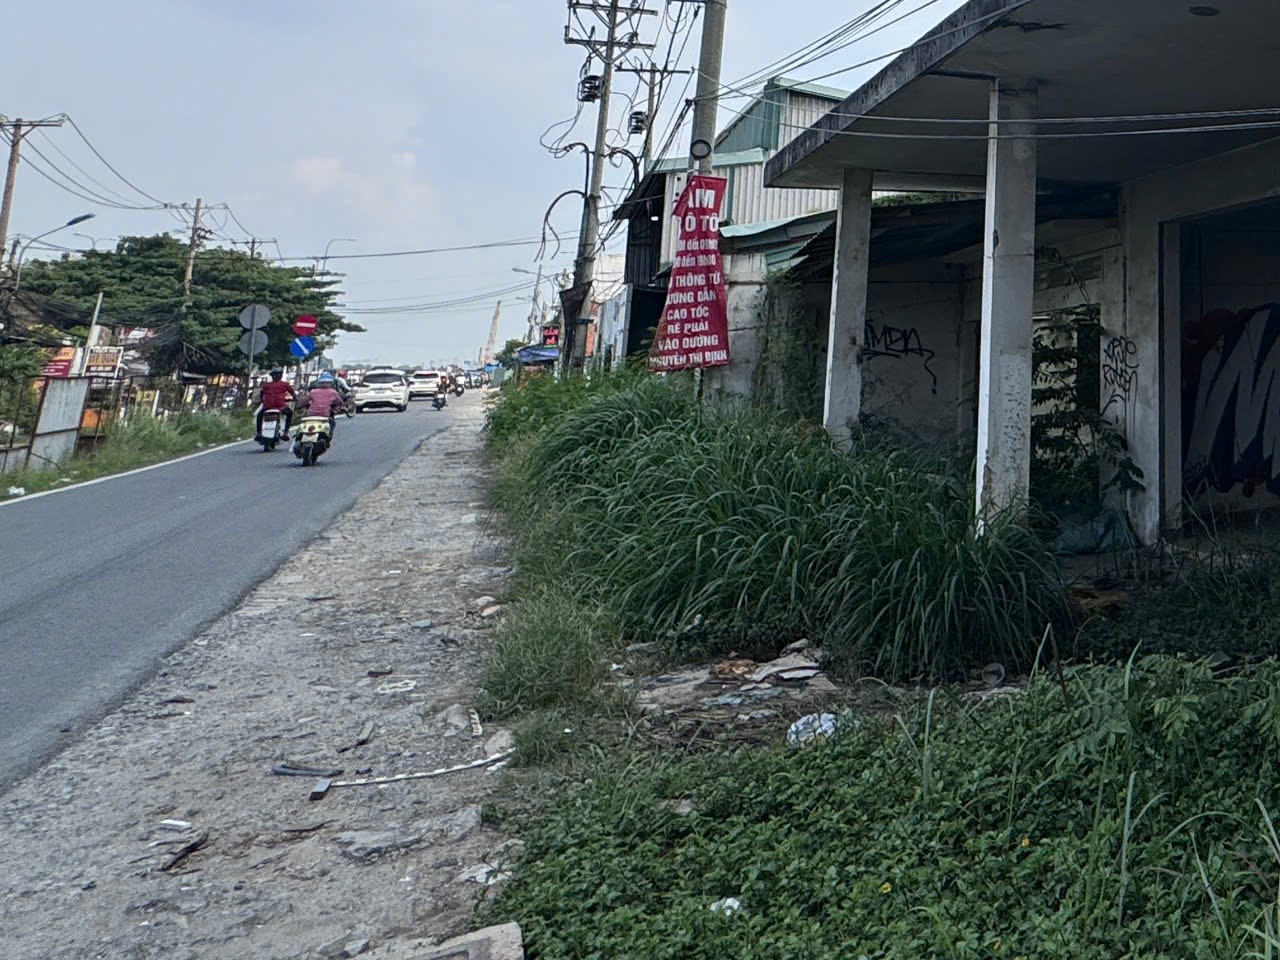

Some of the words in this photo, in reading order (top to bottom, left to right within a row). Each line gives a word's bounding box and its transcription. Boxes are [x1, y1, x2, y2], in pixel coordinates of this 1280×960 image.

[676, 272, 706, 288] THÔNG
[667, 308, 687, 321] CAO
[690, 303, 709, 319] TỐC
[658, 337, 679, 351] VÀO
[682, 334, 719, 349] ĐƯỜNG
